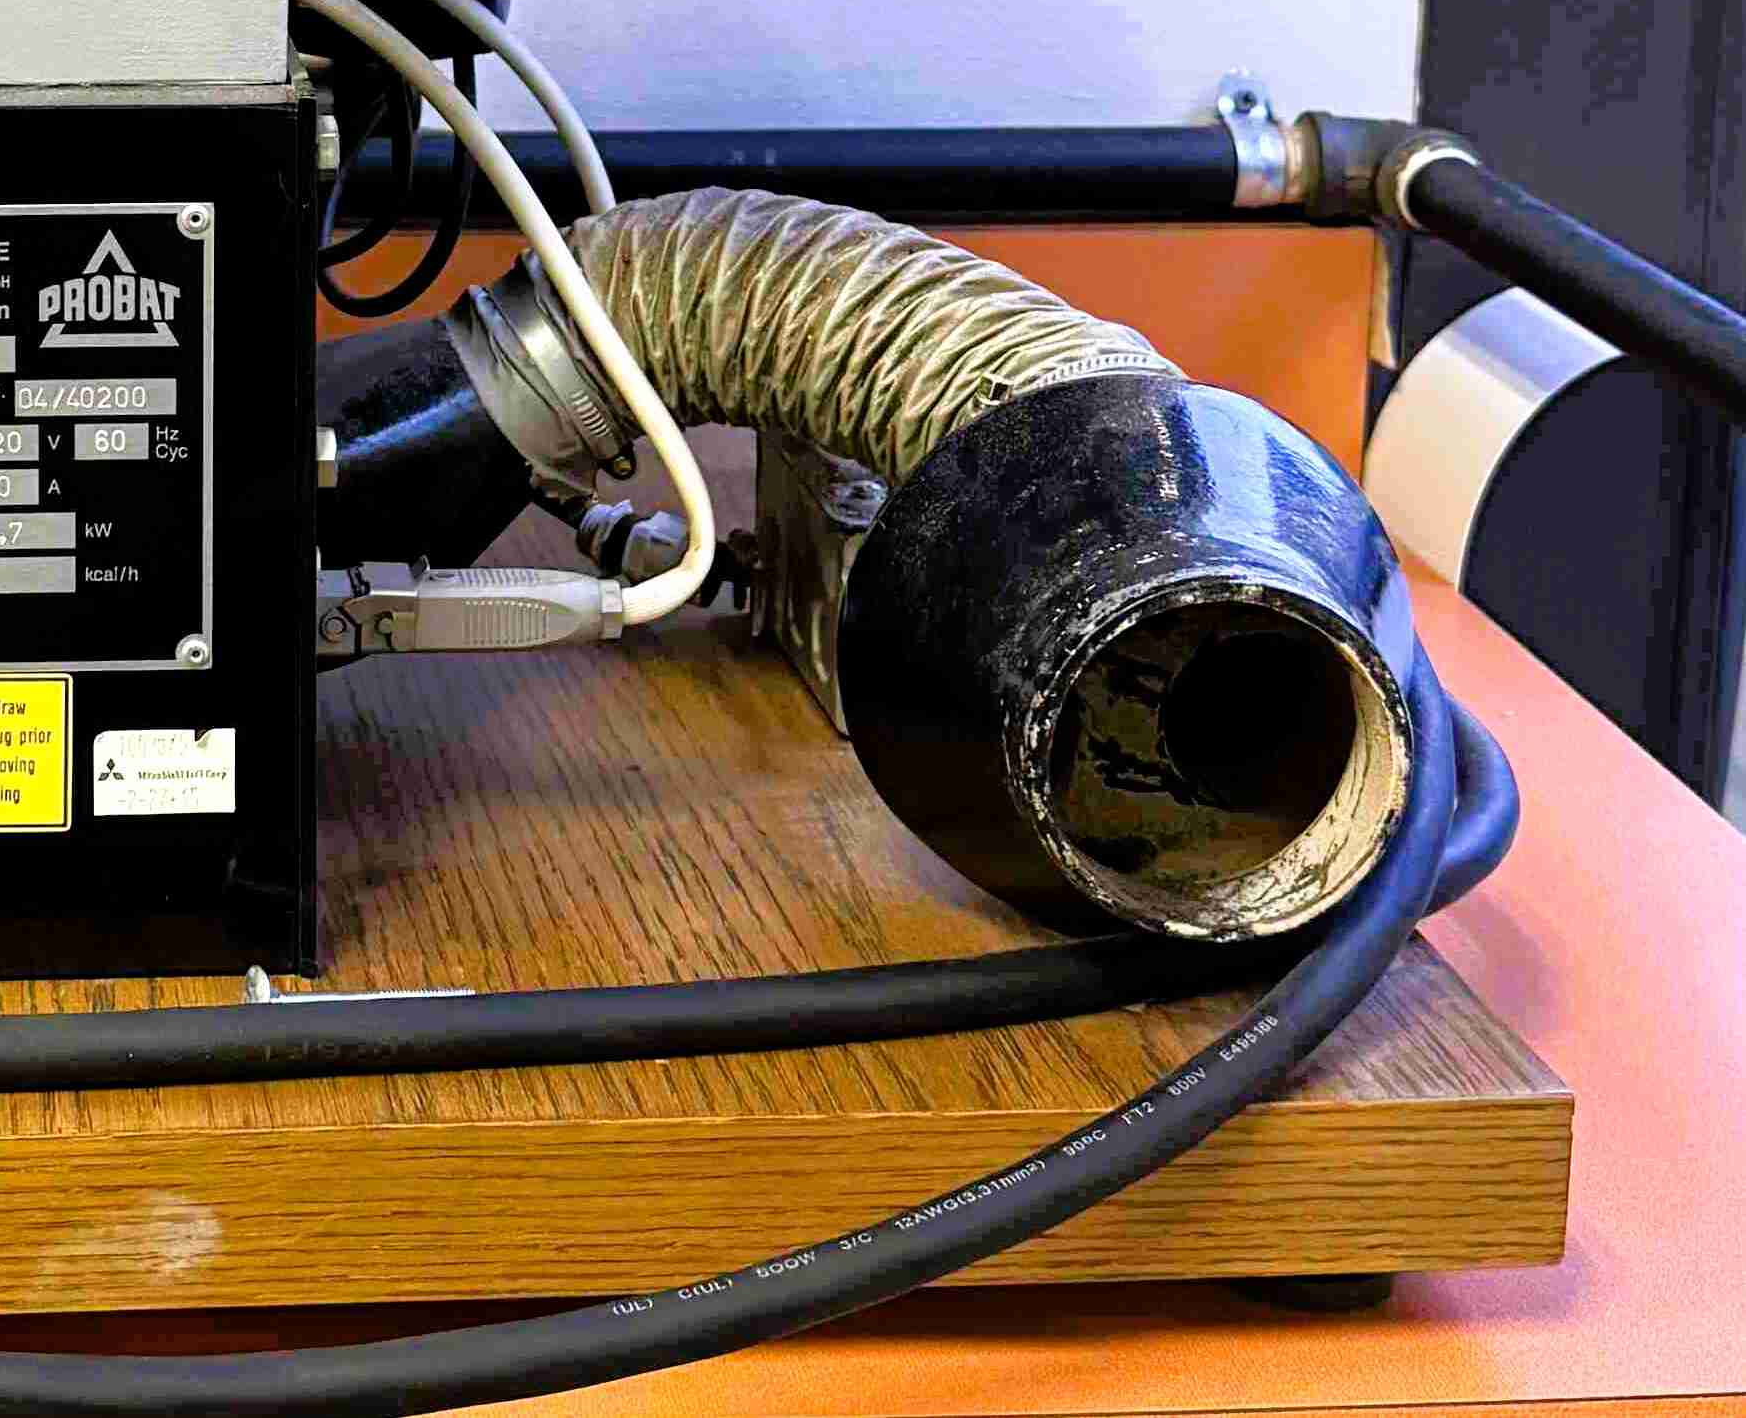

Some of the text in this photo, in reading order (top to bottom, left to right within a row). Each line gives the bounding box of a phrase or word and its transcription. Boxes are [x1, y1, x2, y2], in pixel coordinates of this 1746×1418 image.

[38, 273, 181, 322] PROBAT
[18, 385, 146, 410] 04/40200
[94, 429, 126, 452] 60
[156, 425, 180, 441] Hz
[156, 442, 188, 462] Cyc
[47, 478, 61, 494] A
[85, 522, 112, 538] kW
[85, 566, 139, 582] kcal/h
[20, 727, 52, 746] prior
[612, 1297, 655, 1316] (UL)
[678, 1278, 734, 1301] C(UL)
[839, 1231, 873, 1252] 3/C
